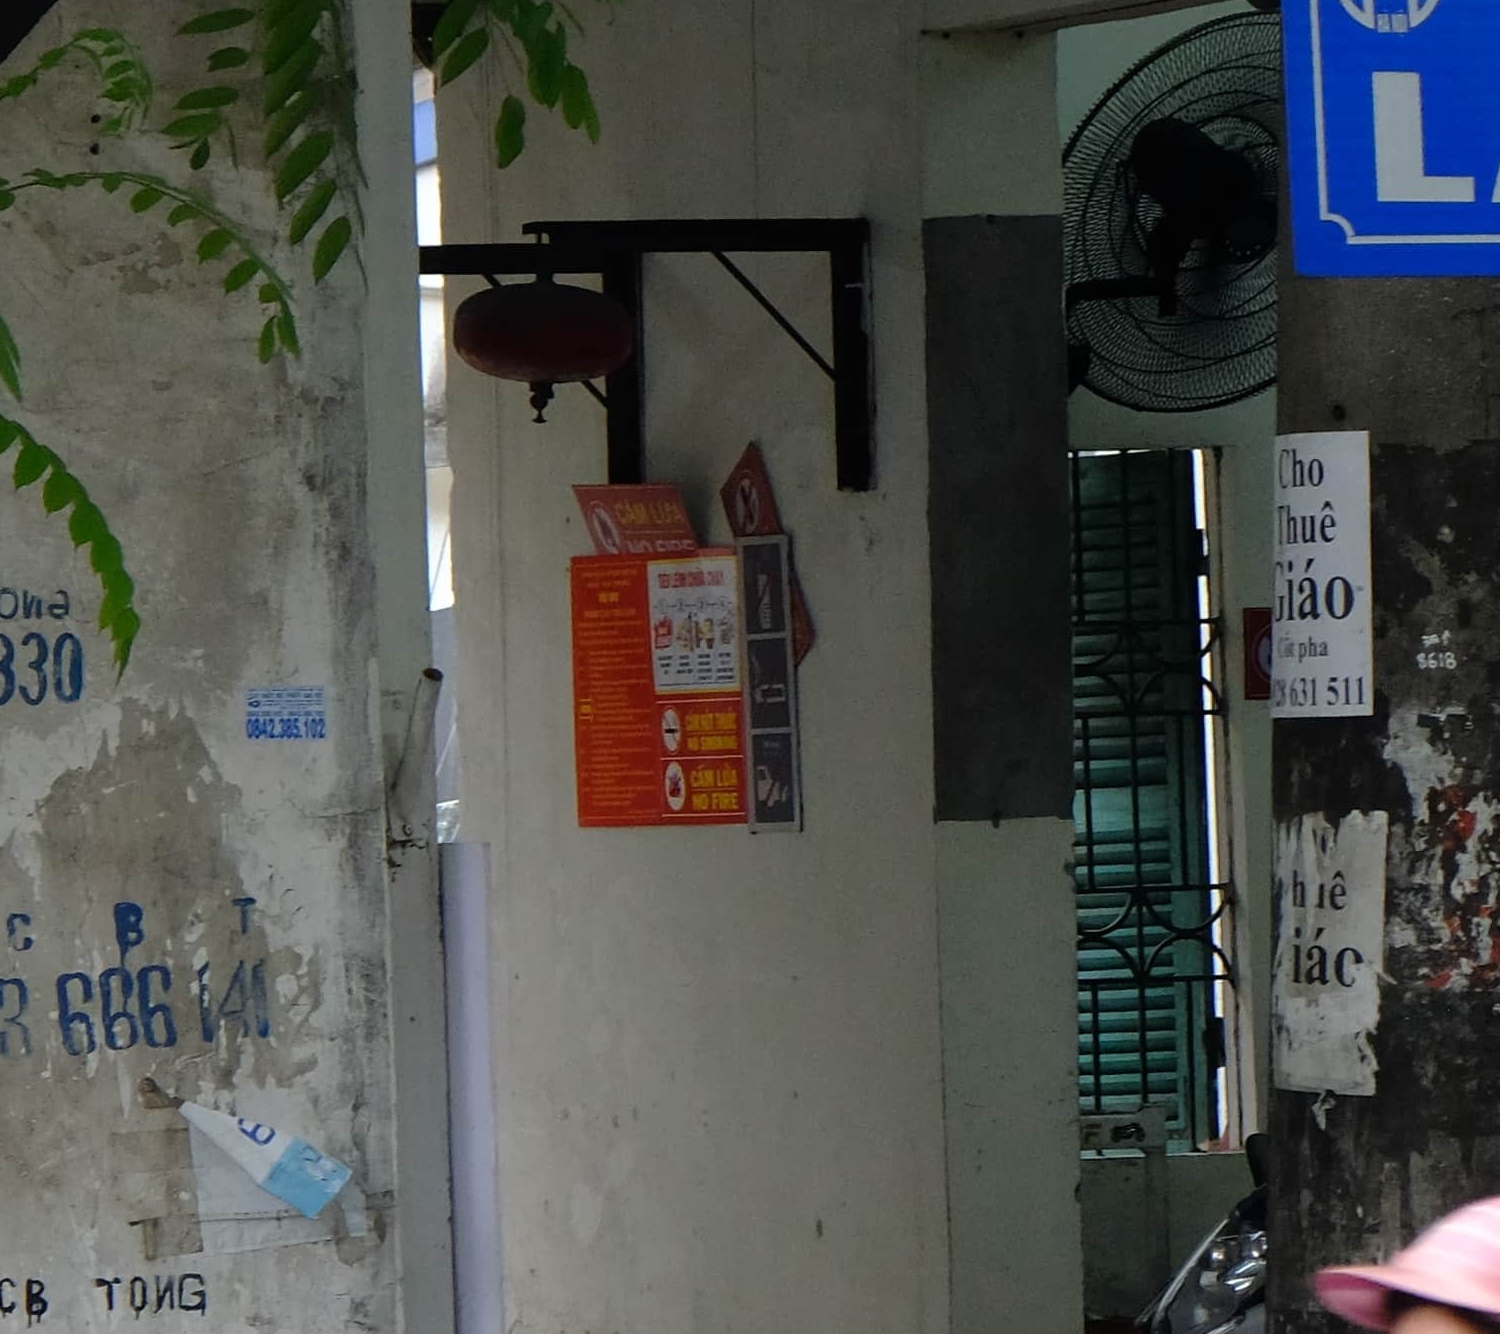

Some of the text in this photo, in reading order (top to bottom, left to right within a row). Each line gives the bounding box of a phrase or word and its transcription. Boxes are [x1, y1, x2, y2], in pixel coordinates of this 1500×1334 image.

[1278, 447, 1324, 490] Cho
[1298, 634, 1329, 664] pha
[1289, 675, 1317, 707] 631
[1326, 675, 1365, 706] 511
[711, 791, 740, 811] FIRE
[113, 901, 145, 949] B
[55, 963, 178, 1058] 666
